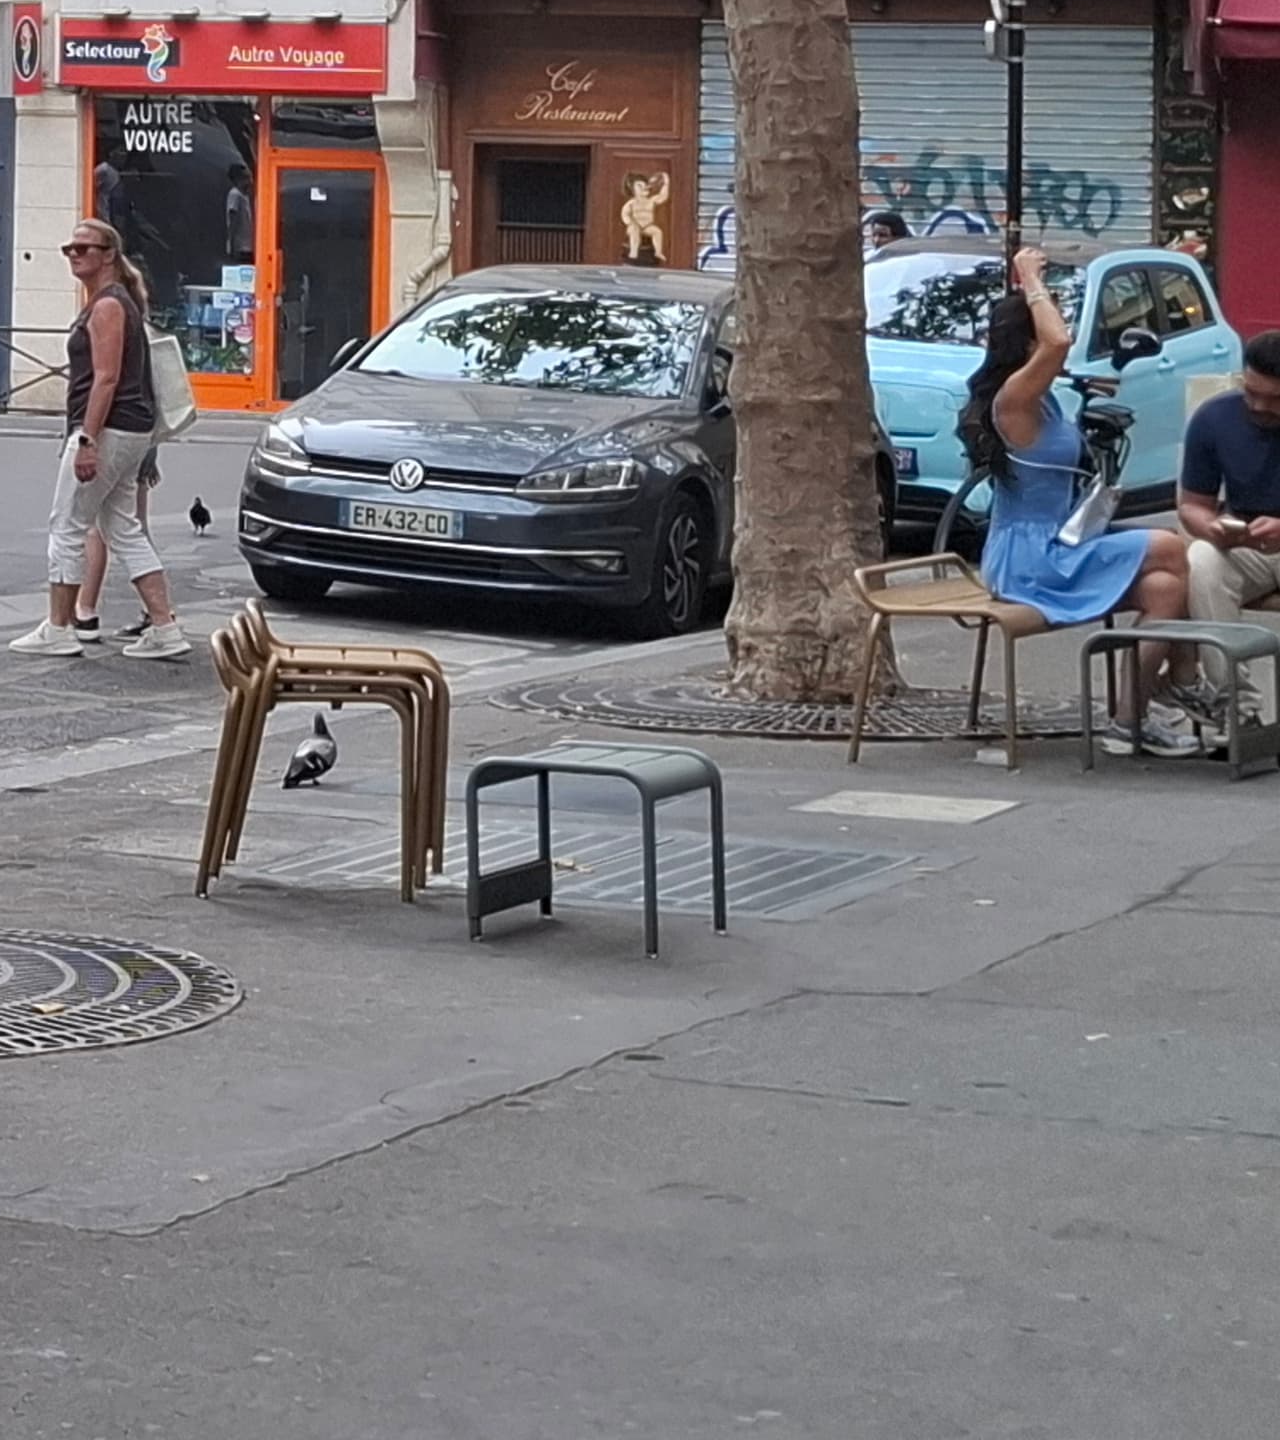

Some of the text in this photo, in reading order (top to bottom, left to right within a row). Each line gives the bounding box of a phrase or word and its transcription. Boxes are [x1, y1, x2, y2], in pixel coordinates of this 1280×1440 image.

[65, 41, 141, 59] Selectour
[228, 45, 345, 67] Autre Voyage
[124, 103, 193, 124] AUTRE
[514, 90, 629, 122] Restaurant
[123, 129, 193, 152] VOYAGE
